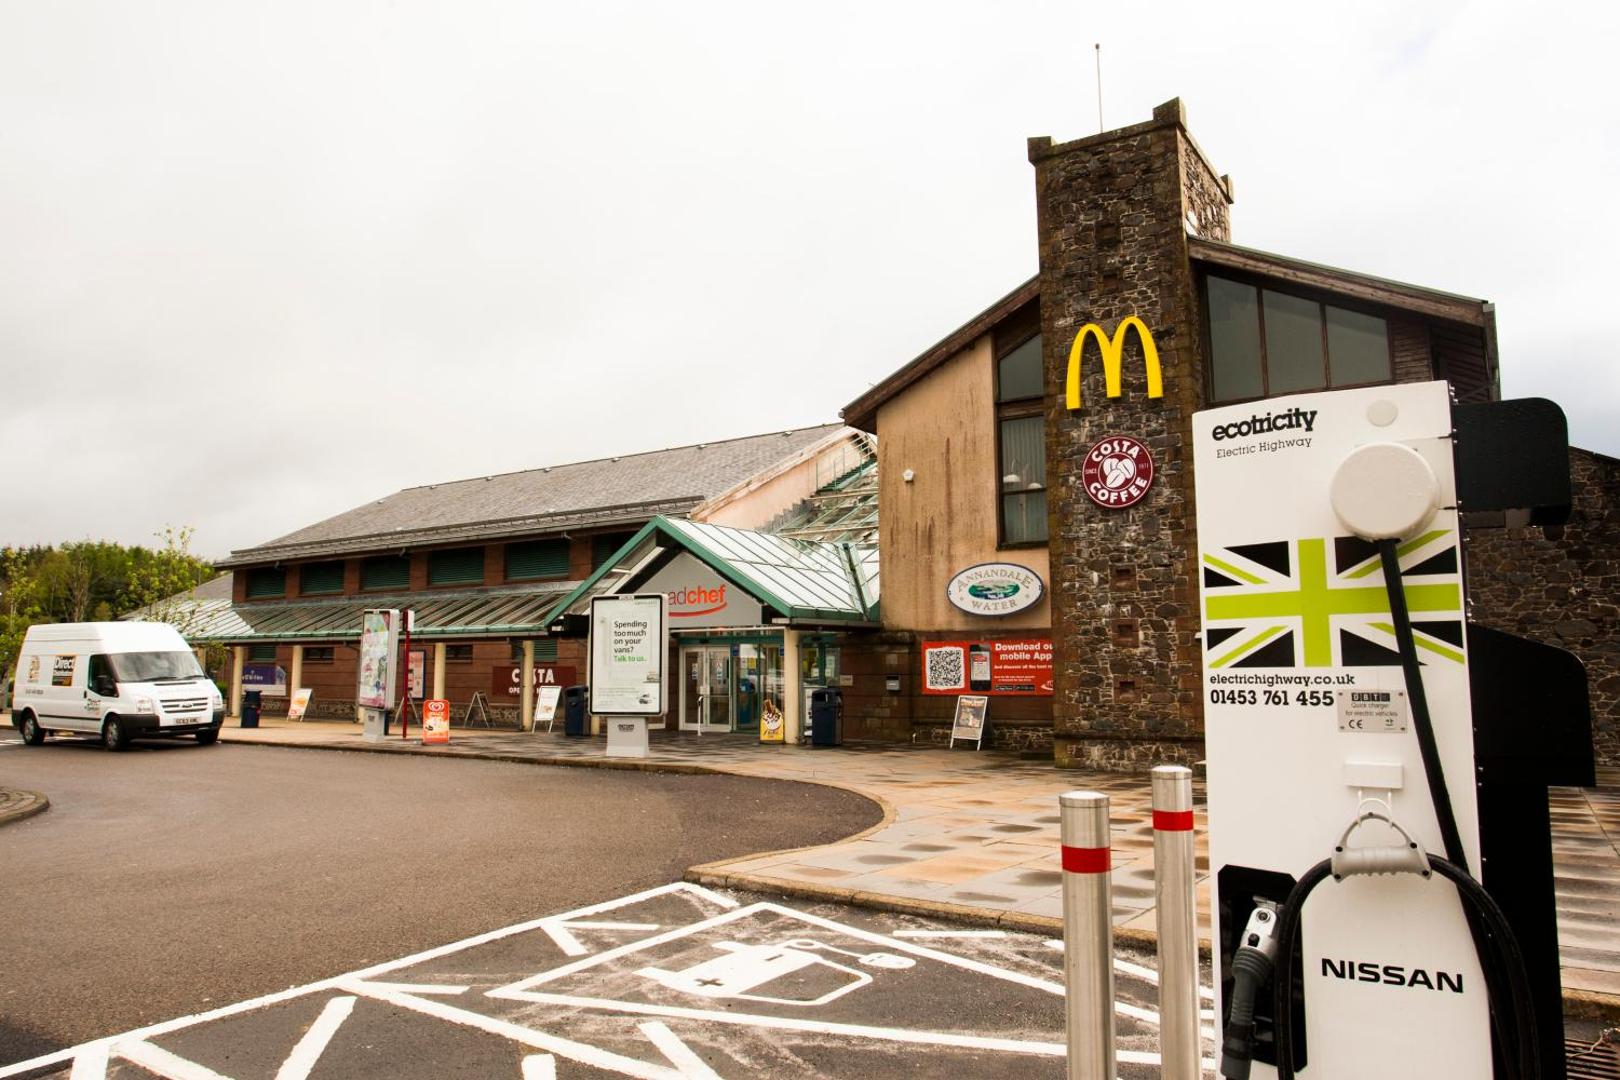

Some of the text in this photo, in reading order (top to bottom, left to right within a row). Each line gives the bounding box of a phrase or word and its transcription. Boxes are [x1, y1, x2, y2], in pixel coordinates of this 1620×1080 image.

[1212, 408, 1317, 441] ecotricity
[1091, 440, 1140, 462] COSTA
[1216, 437, 1312, 459] Electric Highway
[1089, 476, 1148, 504] COFFEE
[957, 568, 1034, 593] ANNANDALE
[667, 584, 726, 604] adchef
[971, 599, 1018, 611] WATER
[613, 620, 648, 630] Spending
[624, 639, 642, 647] your
[995, 642, 1041, 651] Download
[1000, 651, 1031, 660] mobile
[511, 668, 554, 684] CSTA
[1210, 674, 1355, 687] electrichighway.co.uk
[1210, 690, 1335, 706] 01453 761 455
[1321, 957, 1464, 993] NISSAN
